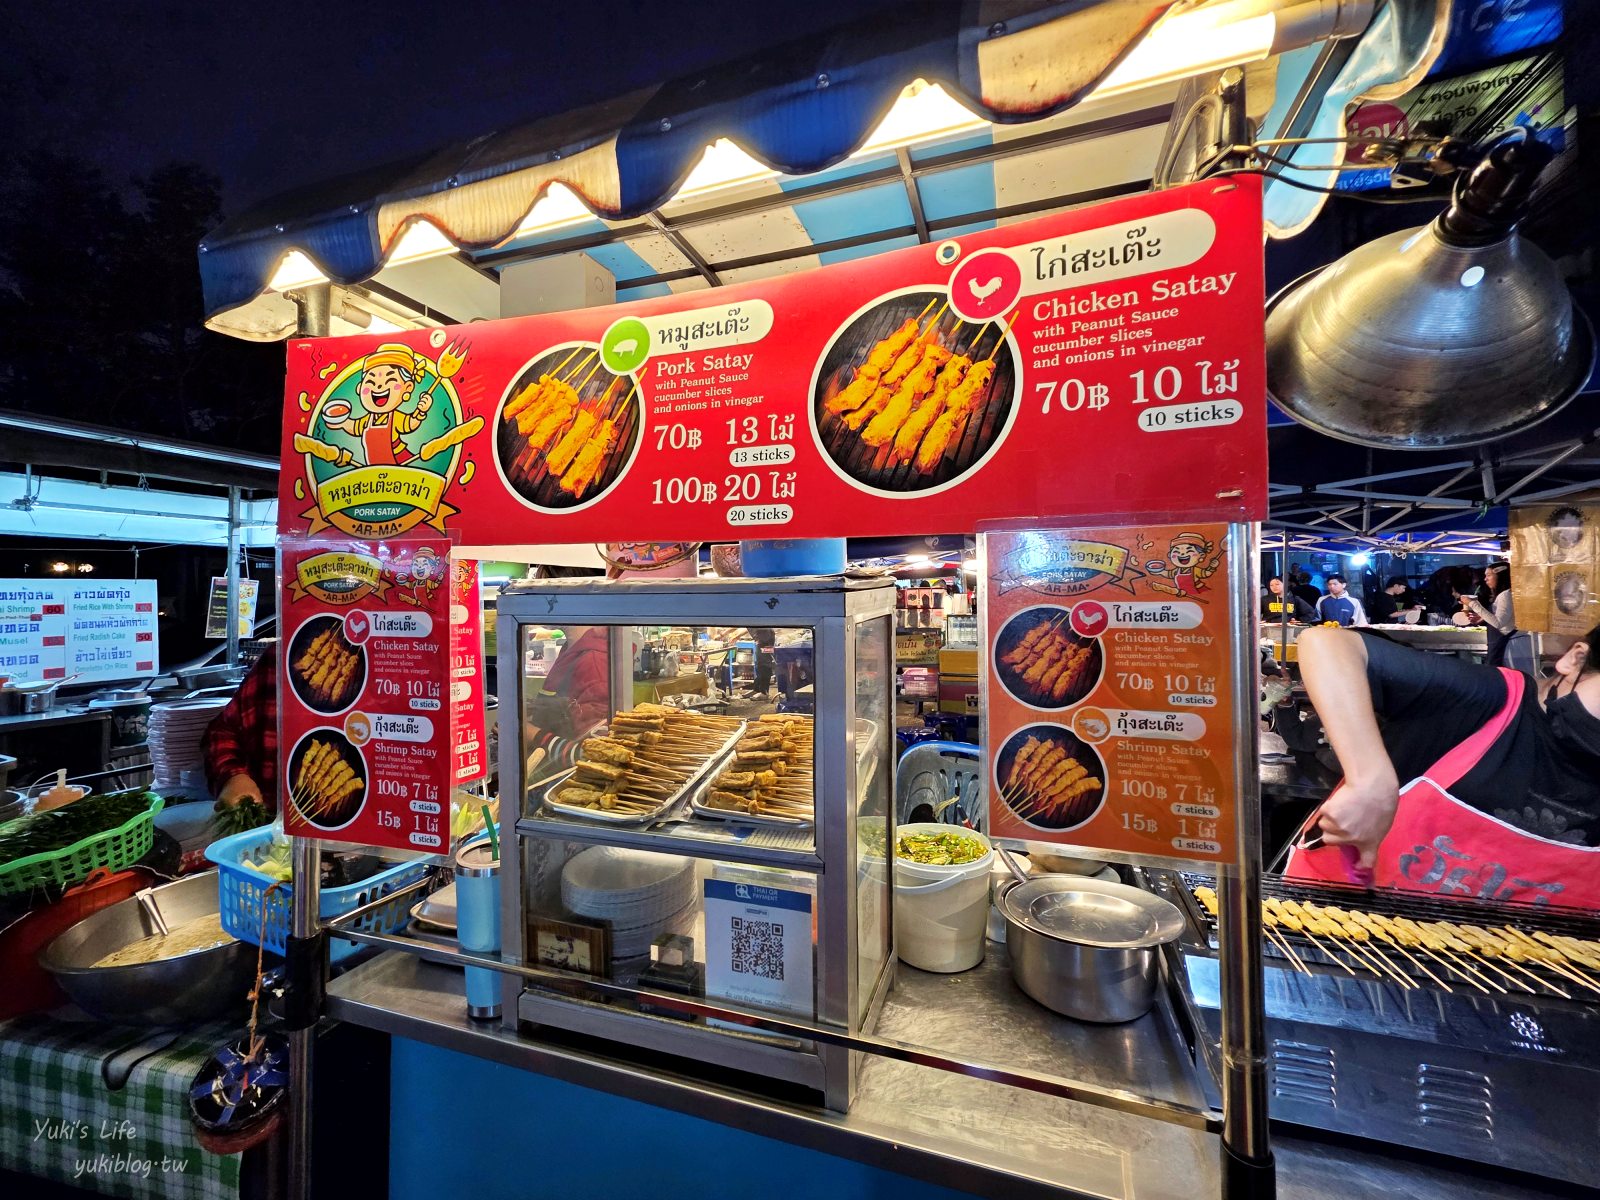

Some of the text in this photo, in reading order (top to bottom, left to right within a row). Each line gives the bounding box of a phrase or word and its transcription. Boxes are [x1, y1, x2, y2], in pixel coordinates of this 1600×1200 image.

[1030, 226, 1161, 280] ไก่สะเต๊ะ
[1032, 272, 1237, 321] Chicken Satay
[658, 307, 750, 350] หมูสะเต๊ะ
[1032, 306, 1179, 340] with Peanut Sauce
[1032, 327, 1153, 354] cucumber slices
[1033, 335, 1205, 369] and onions in vinegar
[656, 354, 753, 377] Pork Satay
[655, 373, 749, 390] with Peanut Sauce
[1129, 366, 1183, 404] 10
[1195, 359, 1240, 396] ไม้
[654, 386, 732, 403] cucumber slices
[654, 395, 764, 414] and onions in vinegar
[1145, 405, 1235, 427] 10 sticks
[726, 416, 759, 445] 13
[767, 414, 796, 441] ไม้
[734, 448, 790, 463] 13 sticks
[328, 472, 430, 505] หมูสะเต๊ะอาม่า
[723, 473, 761, 501] 20
[769, 471, 797, 499] ไม้
[354, 507, 401, 517] PORK SATAY
[730, 508, 788, 521] 20 sticks
[7, 605, 36, 615] Shrimp
[73, 603, 87, 611] Fried
[89, 603, 101, 611] Rice
[115, 602, 134, 611] Shrimp
[1113, 604, 1179, 623] ไก่สะเต๊ะ
[372, 613, 417, 631] ไก่สะเต๊ะ
[73, 633, 88, 642] Fried
[137, 633, 151, 641] 50
[1114, 632, 1215, 646] Chicken Satay
[373, 640, 410, 651] Chicken
[412, 641, 440, 654] Satay
[406, 680, 423, 696] 10
[426, 681, 440, 697] ไม้
[1164, 674, 1189, 692] 10
[1194, 675, 1216, 693] ไม้
[420, 700, 439, 709] sticks
[1171, 695, 1214, 705] 10 sticks
[375, 716, 419, 737] กุ้งสะเต๊ะ
[1117, 712, 1184, 735] กุ้งสะเต๊ะ
[457, 731, 464, 744] 7
[375, 742, 437, 759] Shrimp Satay
[1117, 740, 1212, 758] Shrimp Satay
[412, 782, 421, 799] 7
[425, 784, 439, 800] ไม้
[1175, 783, 1188, 800] 7
[1194, 785, 1215, 803] ไม้
[418, 803, 437, 812] sticks
[1176, 804, 1214, 816] 7 sticks
[413, 815, 421, 831] 1
[425, 816, 439, 832] ไม้
[1178, 818, 1189, 836] 1
[412, 834, 437, 844] 1 sticks
[1178, 839, 1215, 851] 1 sticks
[752, 886, 778, 897] THAI QR
[752, 893, 778, 901] PAYMENT
